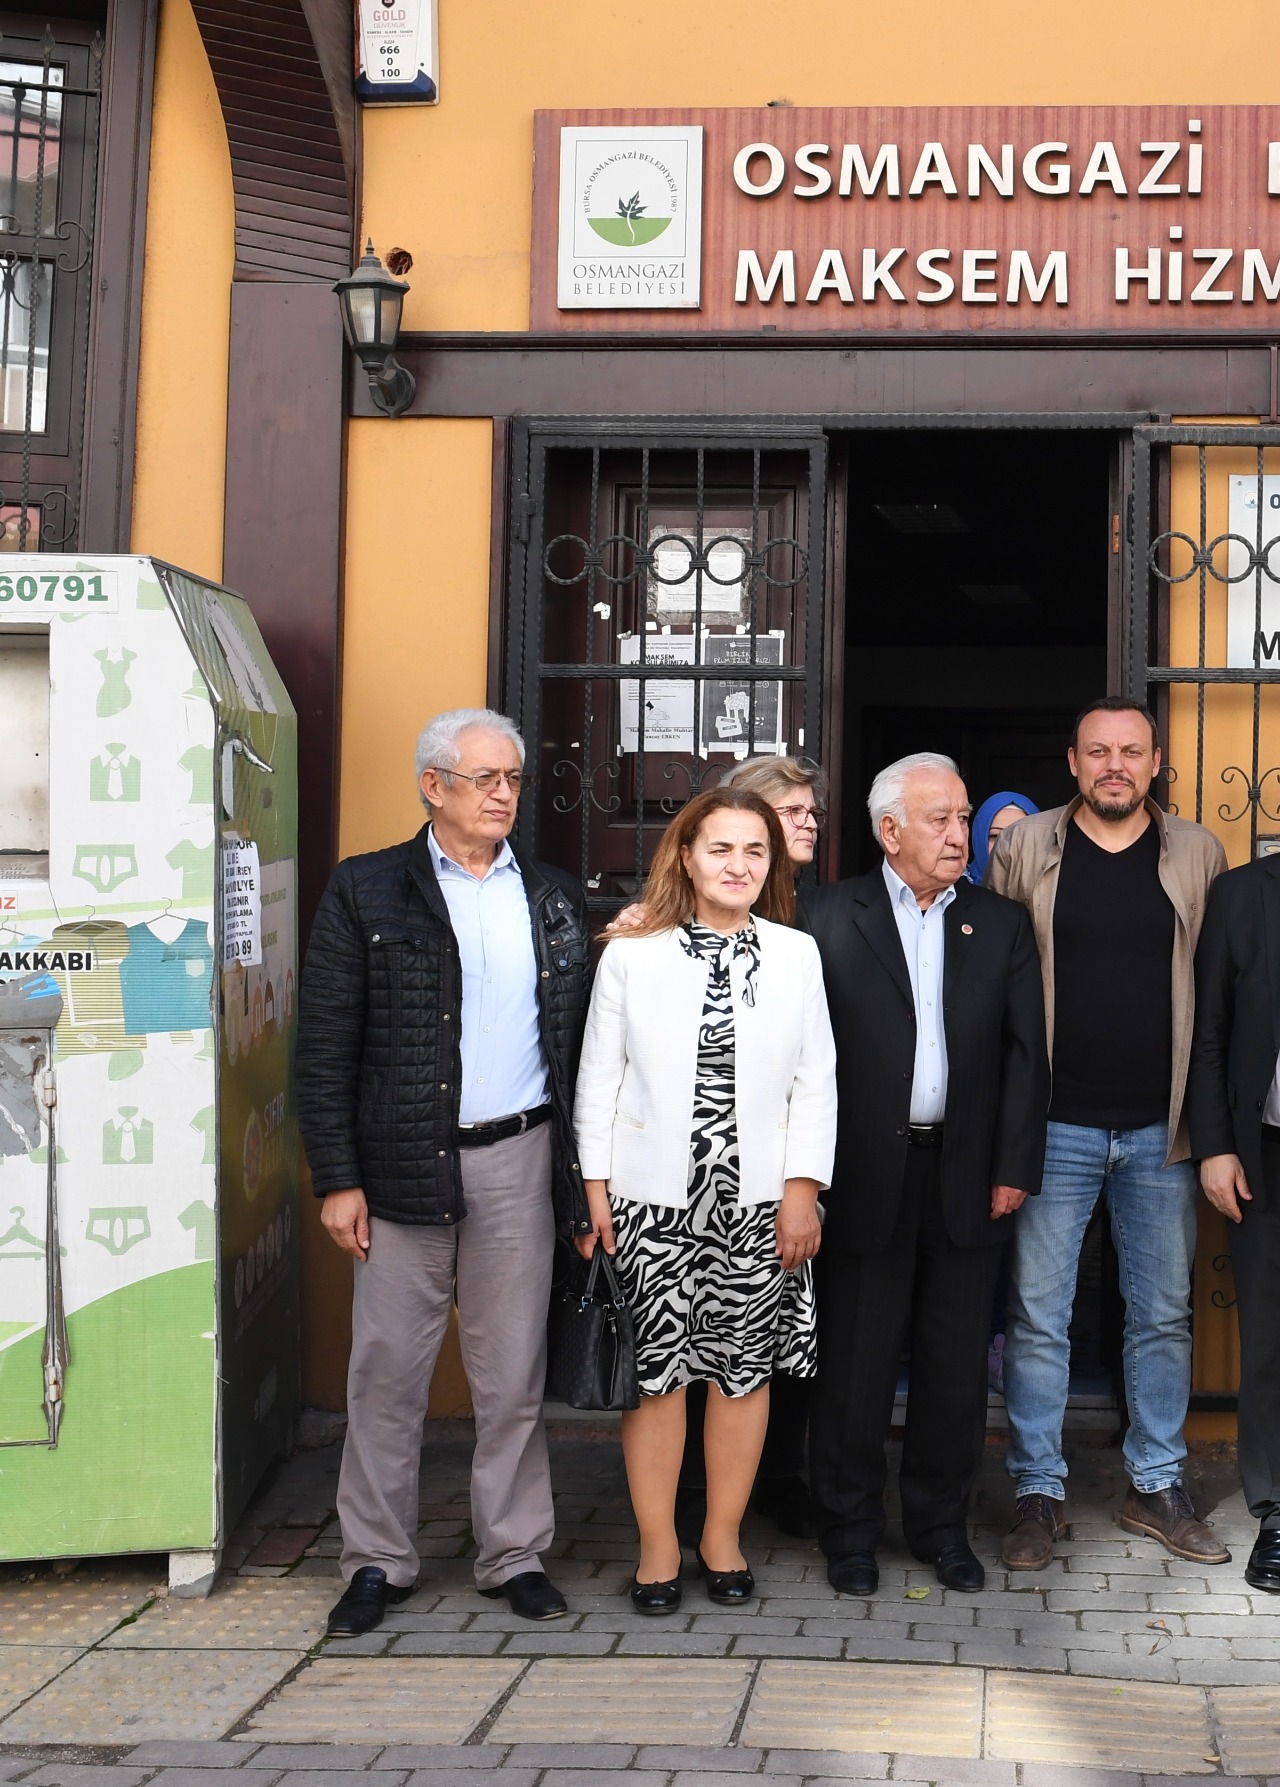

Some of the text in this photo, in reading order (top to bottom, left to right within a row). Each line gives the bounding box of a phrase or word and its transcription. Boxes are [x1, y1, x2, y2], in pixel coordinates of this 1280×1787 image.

[373, 9, 406, 21] GOLD
[379, 45, 401, 55] 666
[386, 57, 394, 66] 0
[380, 68, 401, 78] 100
[732, 118, 1203, 199] OSMANGAZİ
[584, 150, 679, 214] BURSA OSMANGAZİ BELEDİYESİ 1987
[572, 262, 686, 279] OSMANGAZİ
[734, 247, 1069, 305] MAKSEM
[573, 281, 686, 295] BELEDİYESİ
[0, 575, 109, 602] 60791
[241, 939, 252, 955] 89
[0, 952, 92, 971] AKKABI
[263, 1091, 285, 1138] SIFIR
